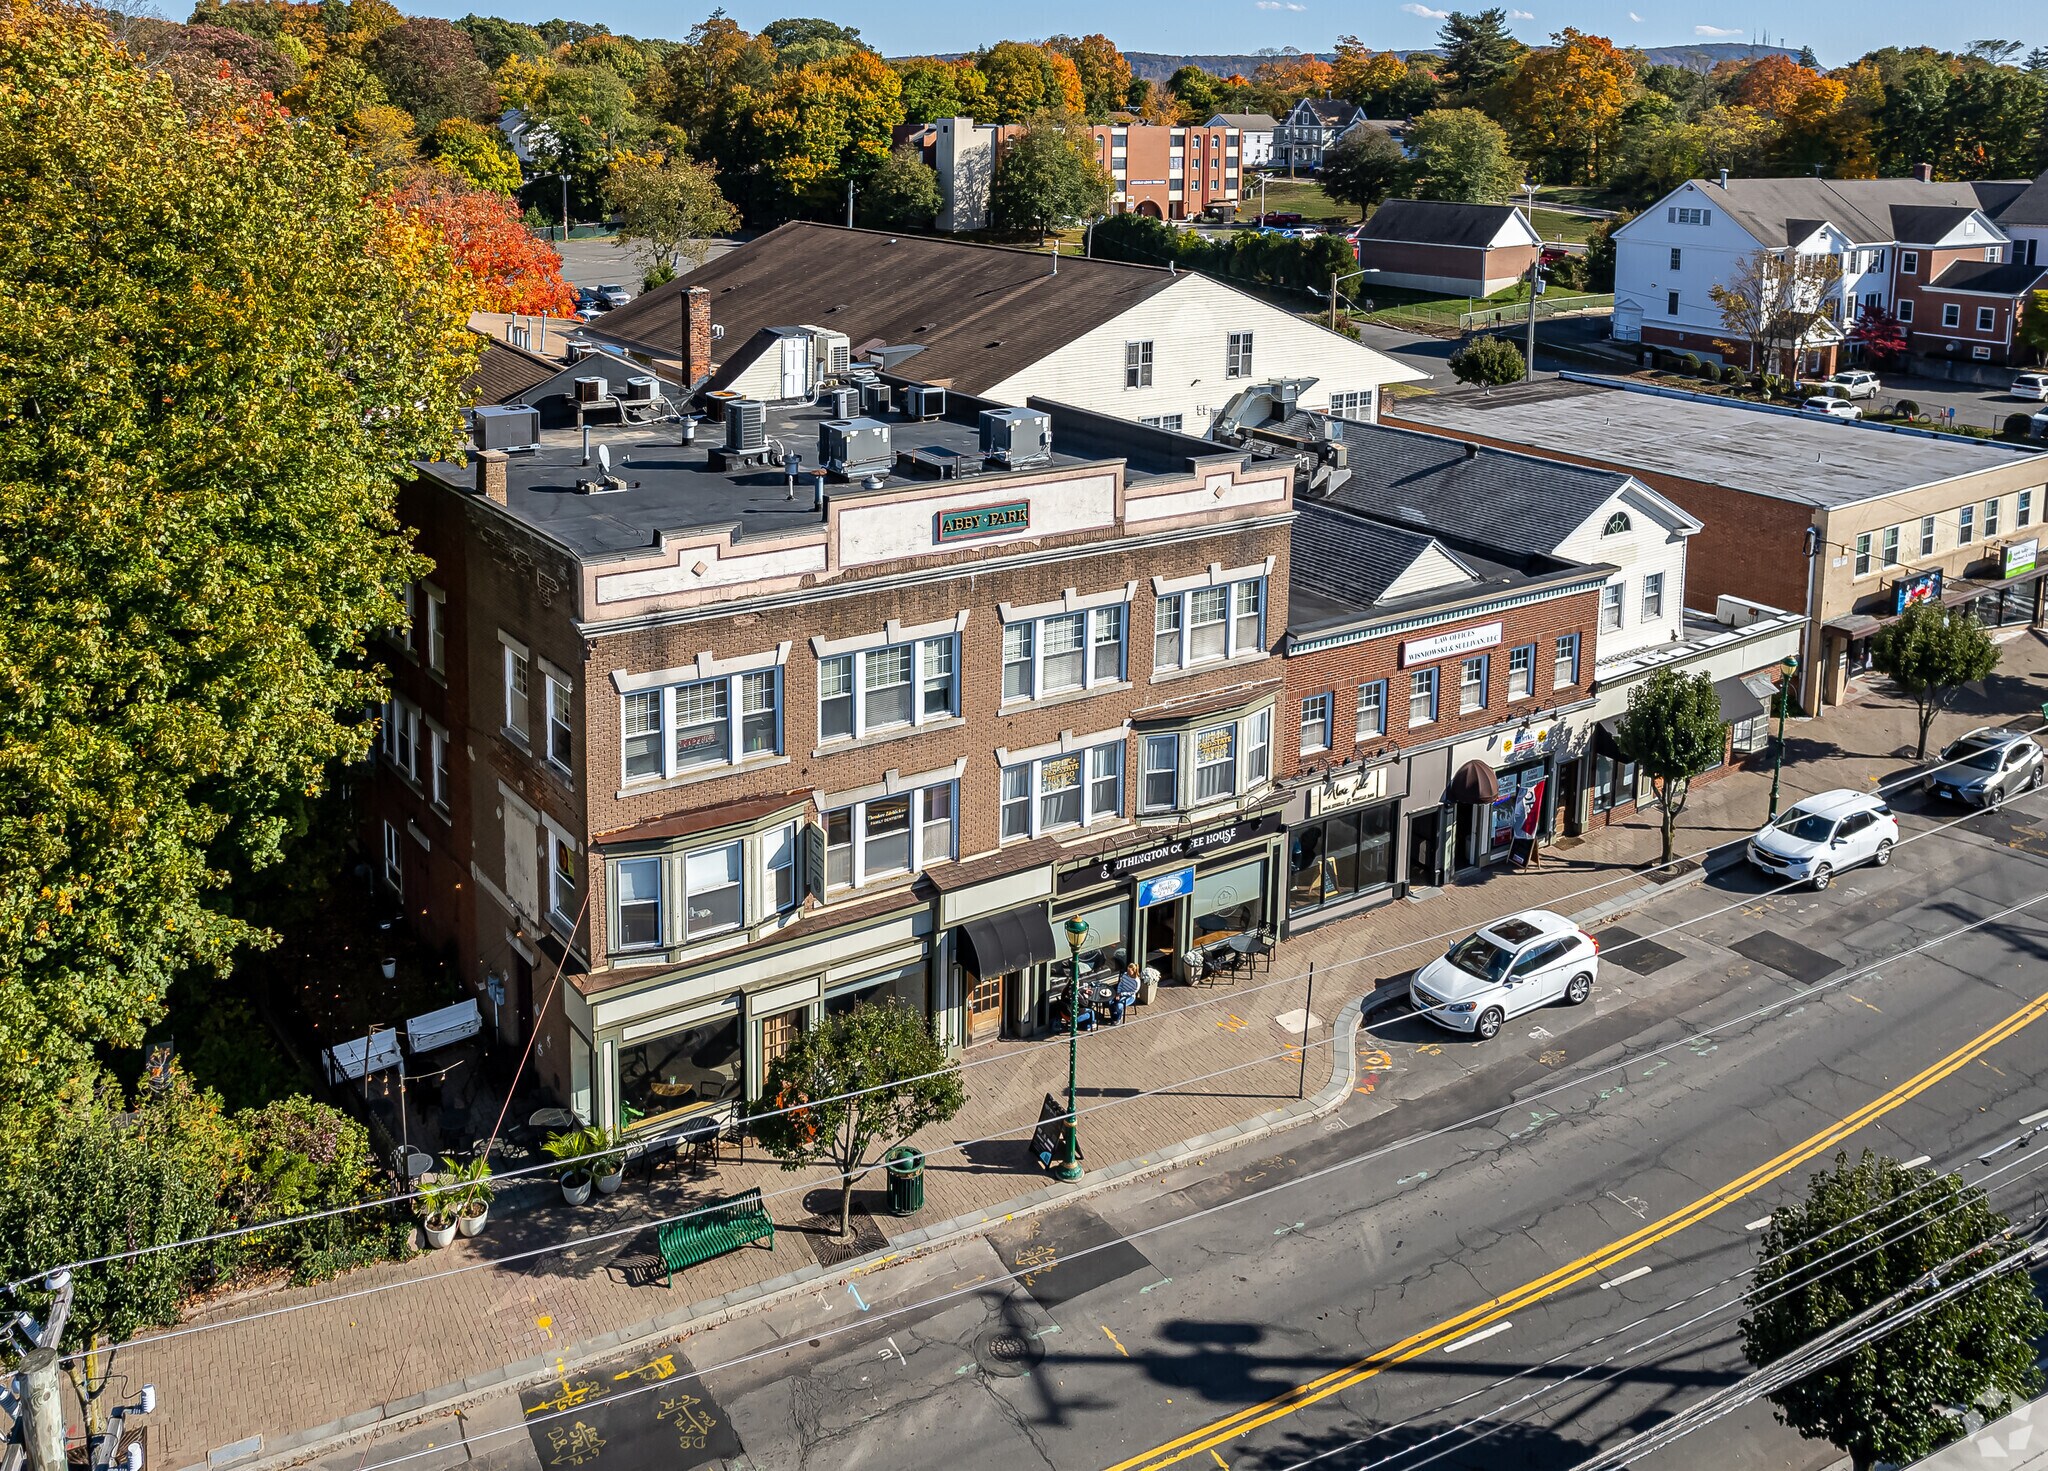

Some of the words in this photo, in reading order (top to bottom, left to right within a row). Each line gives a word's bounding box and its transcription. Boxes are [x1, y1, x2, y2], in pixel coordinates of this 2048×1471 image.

[943, 514, 982, 533] ABBY
[988, 508, 1028, 527] PARK
[1434, 635, 1448, 645] LAW
[1449, 630, 1475, 641] OFFICES
[1486, 634, 1499, 643] LLC
[1100, 846, 1169, 879] SUTHINGTON
[1170, 837, 1204, 854] COEE
[1206, 827, 1237, 844] HOUSE
